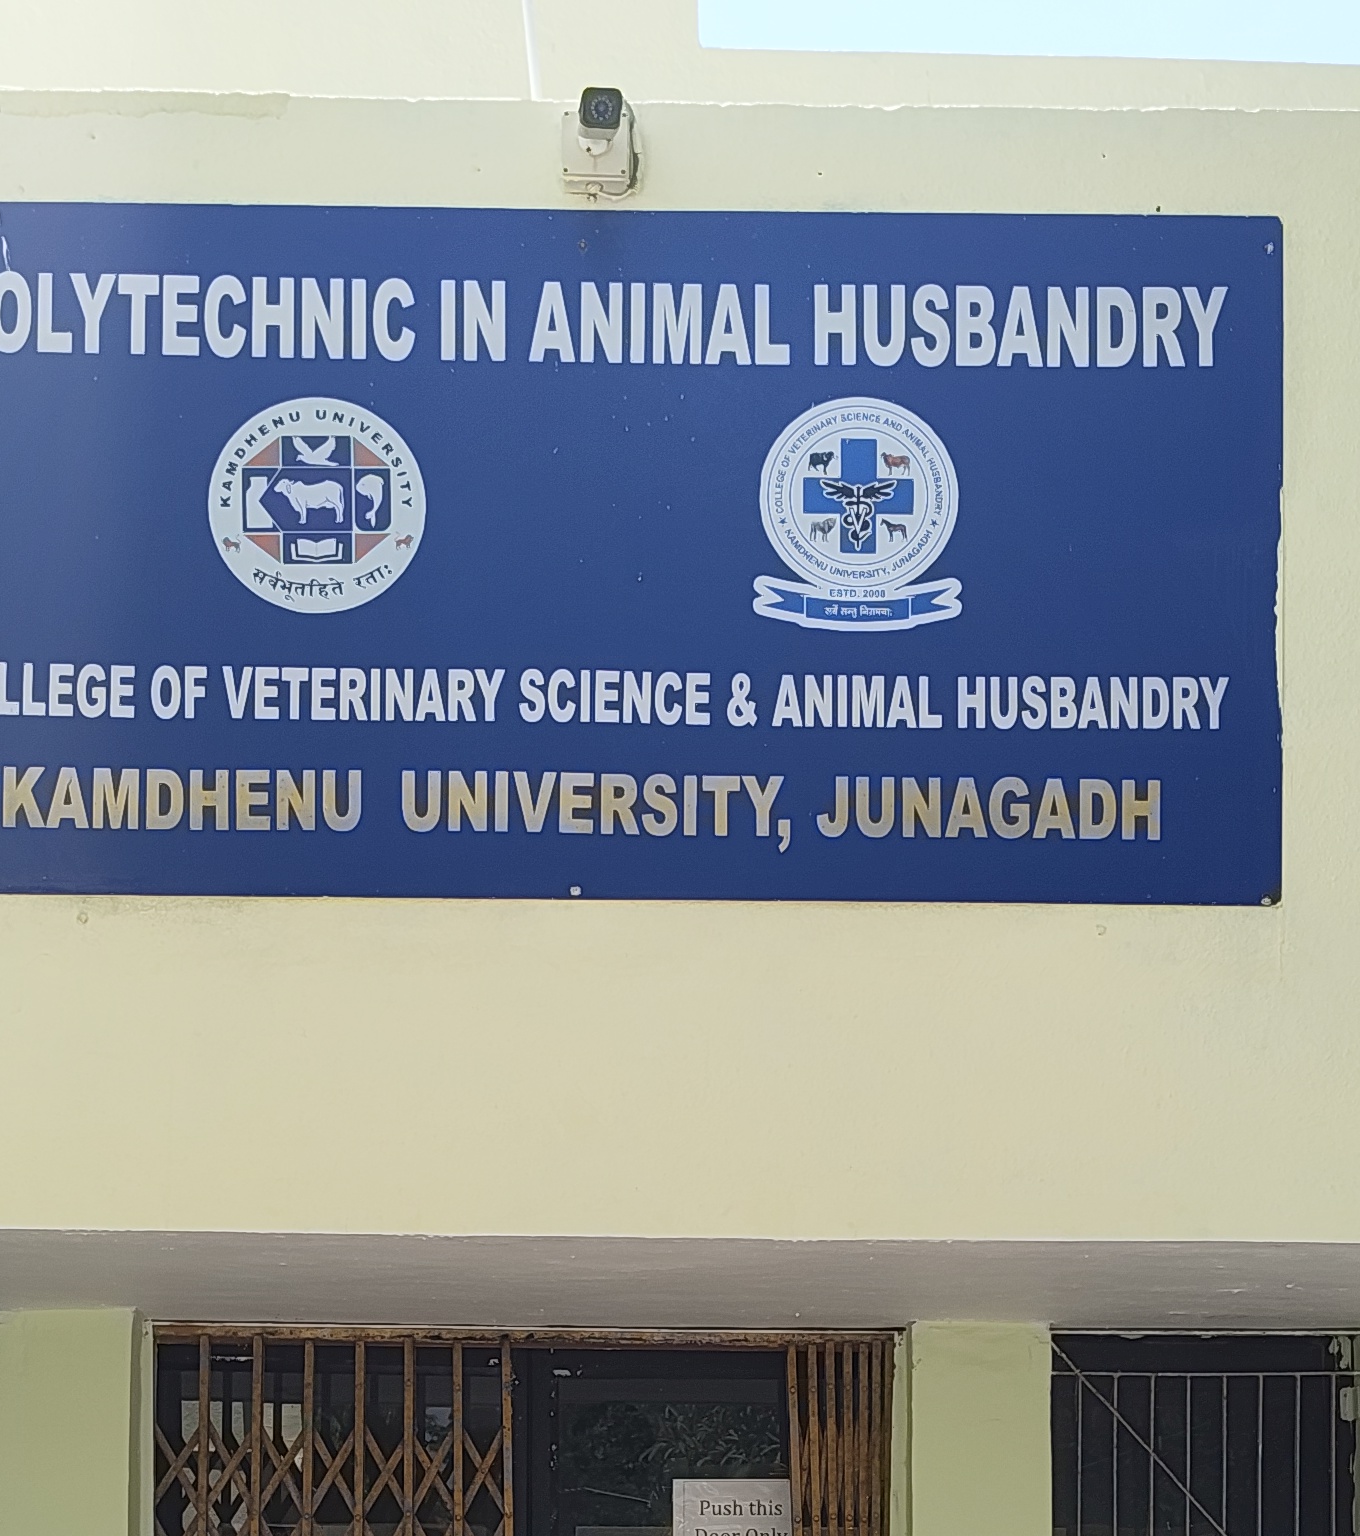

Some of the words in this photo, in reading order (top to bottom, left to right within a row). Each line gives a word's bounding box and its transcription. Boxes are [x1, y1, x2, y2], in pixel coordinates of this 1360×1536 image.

[440, 279, 507, 362] IN
[528, 280, 791, 366] ANIMAL
[813, 283, 1229, 369] HUSBANDRY
[787, 415, 838, 455] VETERINARY
[840, 412, 881, 424] SCIENCE
[882, 417, 903, 432] AND
[220, 411, 301, 508] KAMDHENU
[315, 409, 413, 508] UNIVERSITY
[780, 454, 791, 468] OF
[902, 428, 930, 459] ANIMAL
[774, 469, 787, 514] COLLEGE
[926, 457, 944, 517] HUSBANDRY
[784, 528, 829, 572] KAMDHENU
[891, 529, 934, 572] JUNAGADH
[150, 664, 209, 720] OF
[222, 664, 506, 723] VETERINARY
[518, 668, 711, 727] SCIENCE
[726, 672, 758, 727] &
[771, 674, 943, 729] ANIMAL
[957, 675, 1230, 731] HUSBANDRY
[2, 765, 363, 832] KAMDHENU
[400, 769, 791, 854] UNIVERSITY,
[815, 775, 1161, 841] JUNAGADH
[698, 1499, 743, 1517] Push
[748, 1499, 784, 1517] this
